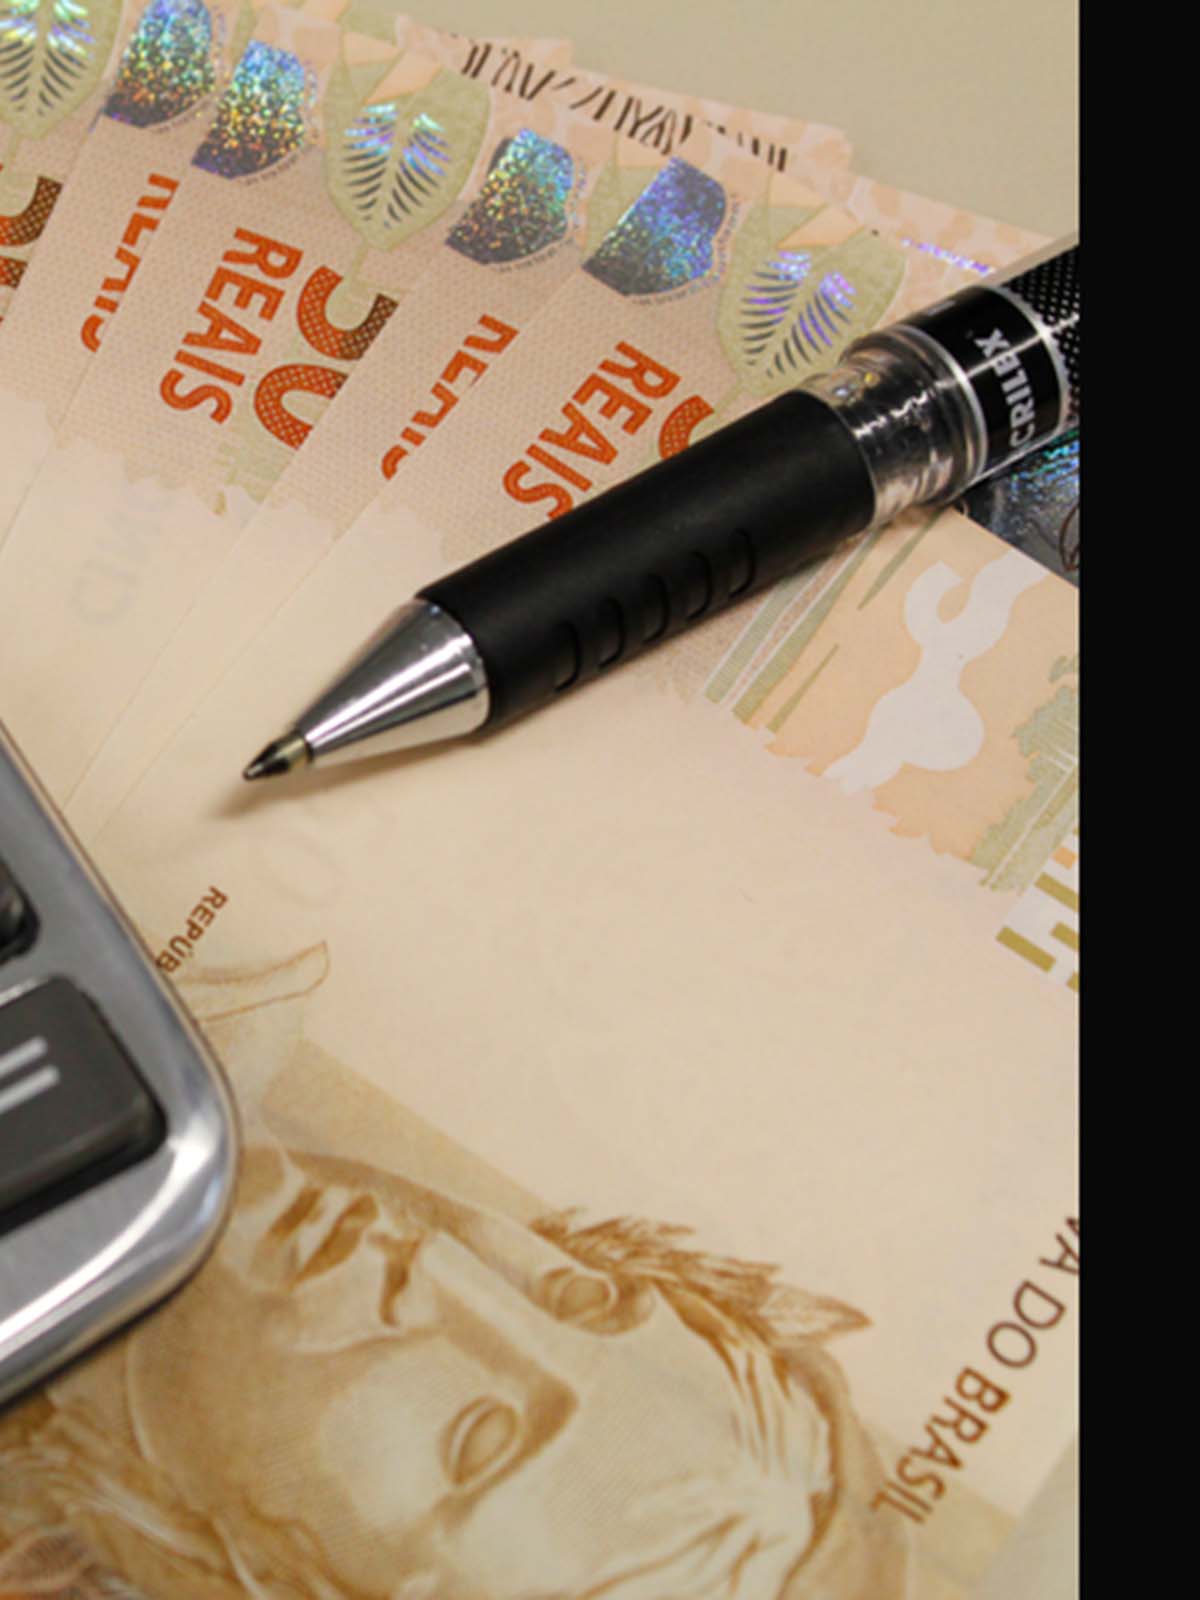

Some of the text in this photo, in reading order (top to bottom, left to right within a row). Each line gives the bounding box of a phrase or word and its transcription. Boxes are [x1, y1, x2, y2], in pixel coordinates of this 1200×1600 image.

[160, 227, 303, 424] REAIS
[503, 341, 680, 520] REAIS
[987, 1280, 1066, 1368] DO
[869, 1367, 1011, 1525] BRASIL
